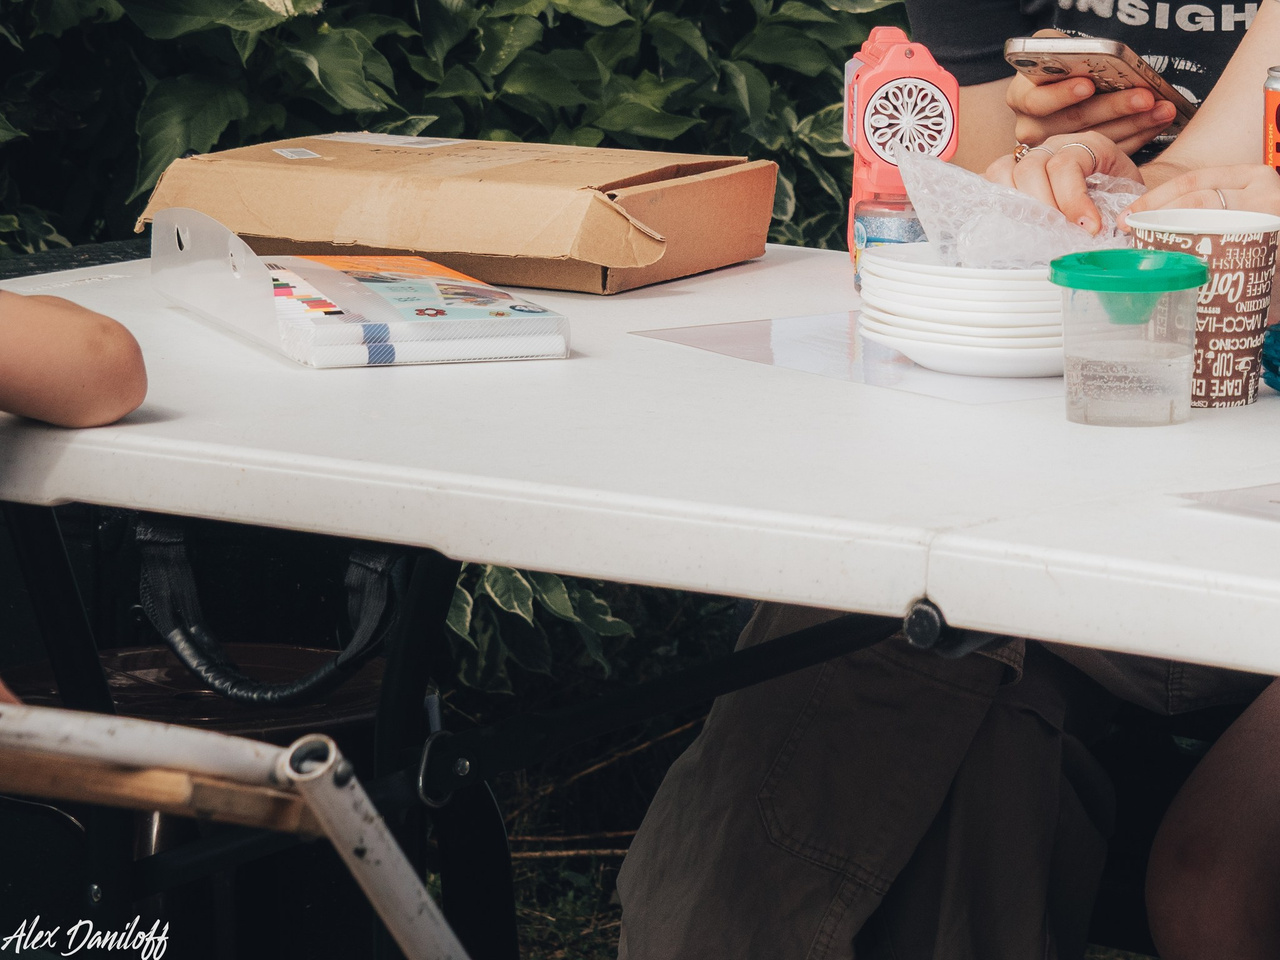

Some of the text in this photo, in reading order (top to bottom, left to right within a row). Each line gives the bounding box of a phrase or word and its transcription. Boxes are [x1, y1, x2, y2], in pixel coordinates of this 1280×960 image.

[1226, 246, 1267, 259] COFFEE
[1212, 257, 1266, 270] TURKISH
[1248, 269, 1271, 285] LATTE
[1246, 281, 1271, 297] CAFFE
[1212, 352, 1233, 377] CUP
[1210, 379, 1242, 399] CAFÉ
